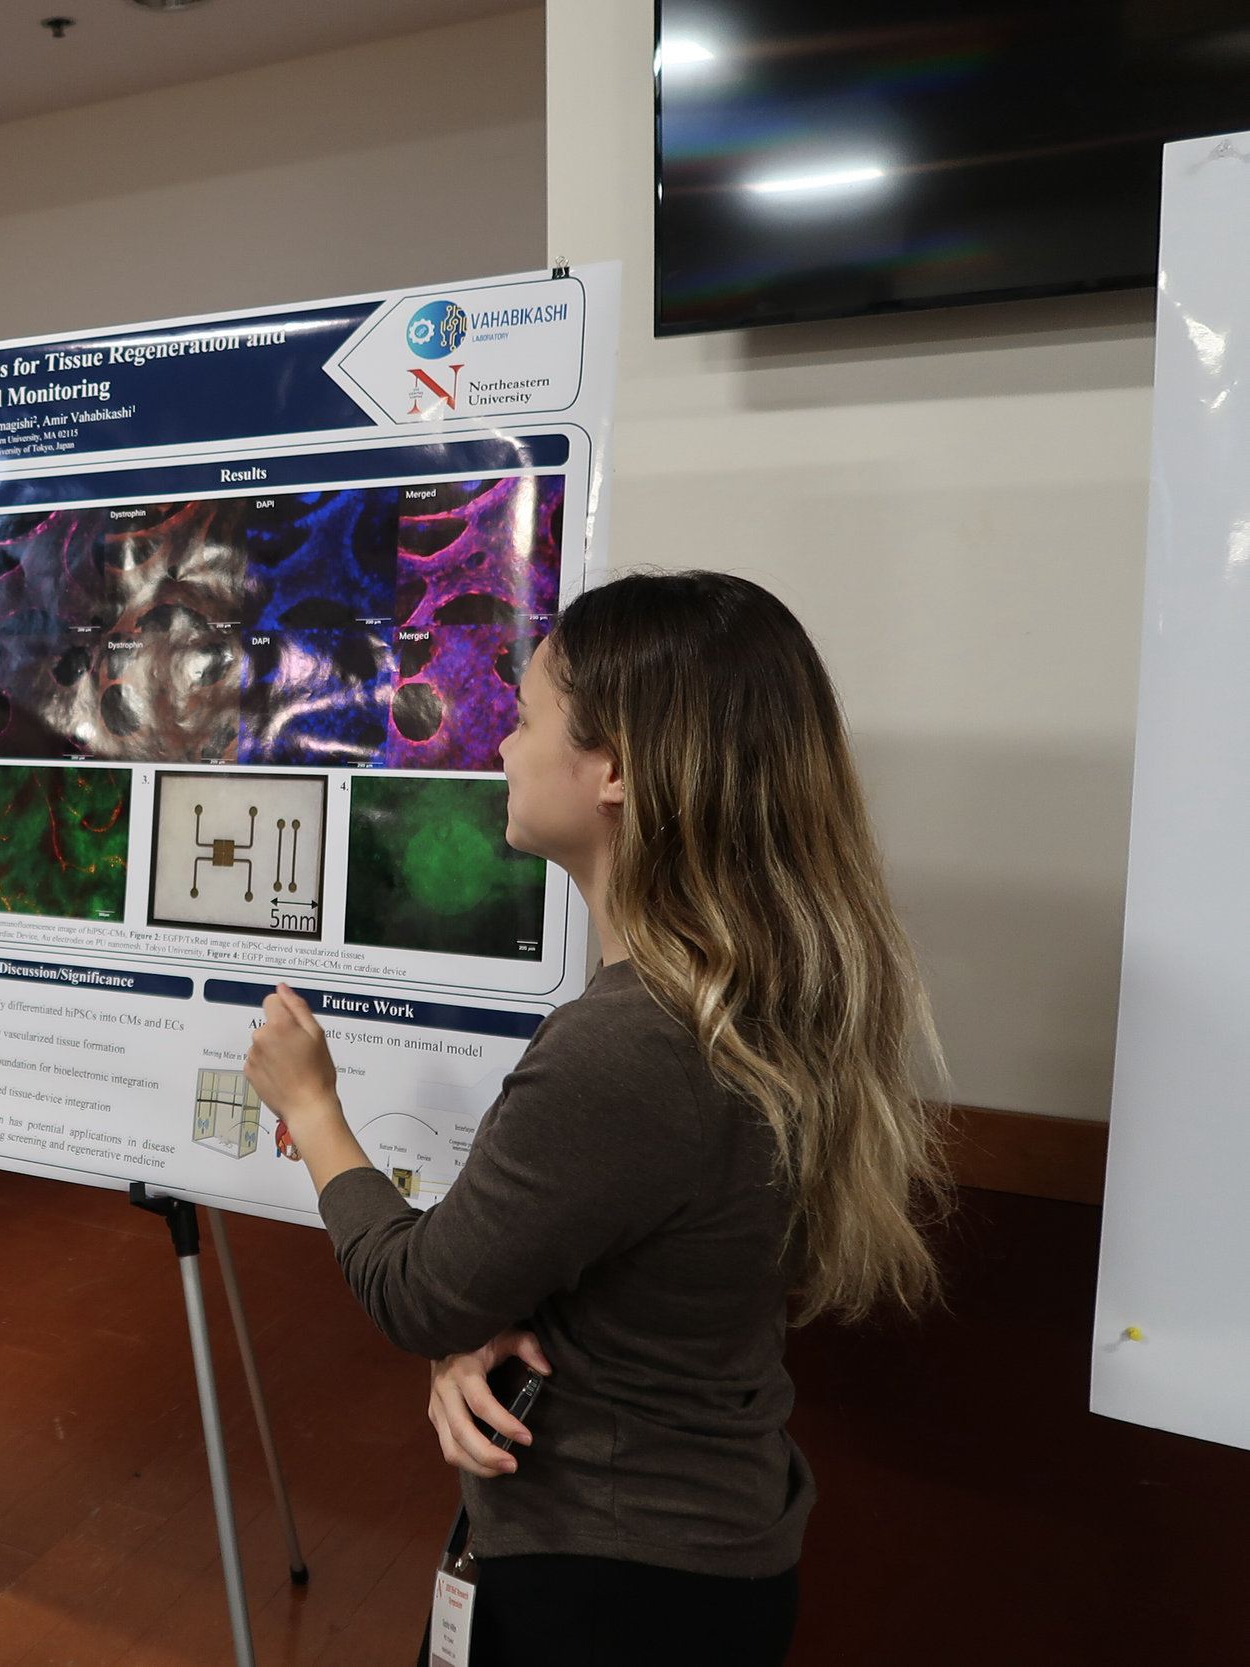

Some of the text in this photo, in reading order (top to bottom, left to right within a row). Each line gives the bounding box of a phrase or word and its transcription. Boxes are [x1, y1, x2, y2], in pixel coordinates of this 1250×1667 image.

[471, 304, 567, 329] VAHABIKASHI
[472, 333, 509, 342] LABORATORY
[13, 357, 40, 376] for
[44, 353, 103, 372] Tissue
[108, 336, 240, 366] Regeneration
[7, 381, 111, 406] Monitoring
[407, 364, 464, 414] N
[469, 378, 550, 392] Northeastern
[468, 393, 532, 408] University
[220, 467, 267, 483] Results
[110, 510, 146, 519] Dystrophin
[256, 500, 275, 508] DAPI
[405, 489, 436, 499] Merged
[108, 642, 143, 650] Dystrophin
[252, 638, 270, 646] DAPI
[399, 632, 429, 641] Merged
[141, 776, 150, 785] 3.
[340, 781, 349, 791] 4.
[269, 908, 316, 932] 5mm
[7, 1000, 62, 1016] differentiated
[64, 1007, 96, 1021] hiPSCs
[99, 1011, 117, 1023] into
[118, 1013, 141, 1026] CMs
[143, 1017, 162, 1028] and
[165, 1018, 184, 1031] ECs
[322, 995, 414, 1019] Future Work
[248, 1018, 266, 1030] Ai
[3, 1030, 54, 1044] vascularized
[56, 1035, 80, 1048] tissue
[82, 1038, 125, 1054] formation
[345, 1033, 383, 1046] system
[387, 1038, 401, 1048] on
[404, 1038, 442, 1053] animal
[447, 1043, 482, 1058] model
[39, 1062, 52, 1074] for
[53, 1064, 108, 1082] bioelectronic
[111, 1073, 159, 1089] integration
[8, 1086, 62, 1104] tissue-device
[64, 1095, 110, 1112] integration
[8, 1115, 22, 1128] has
[27, 1121, 64, 1135] potential
[69, 1128, 122, 1144] applications
[128, 1136, 137, 1148] in
[142, 1137, 175, 1154] disease
[6, 1133, 47, 1150] screening
[48, 1139, 65, 1150] and
[66, 1143, 121, 1160] regenerative
[123, 1153, 165, 1168] medicine
